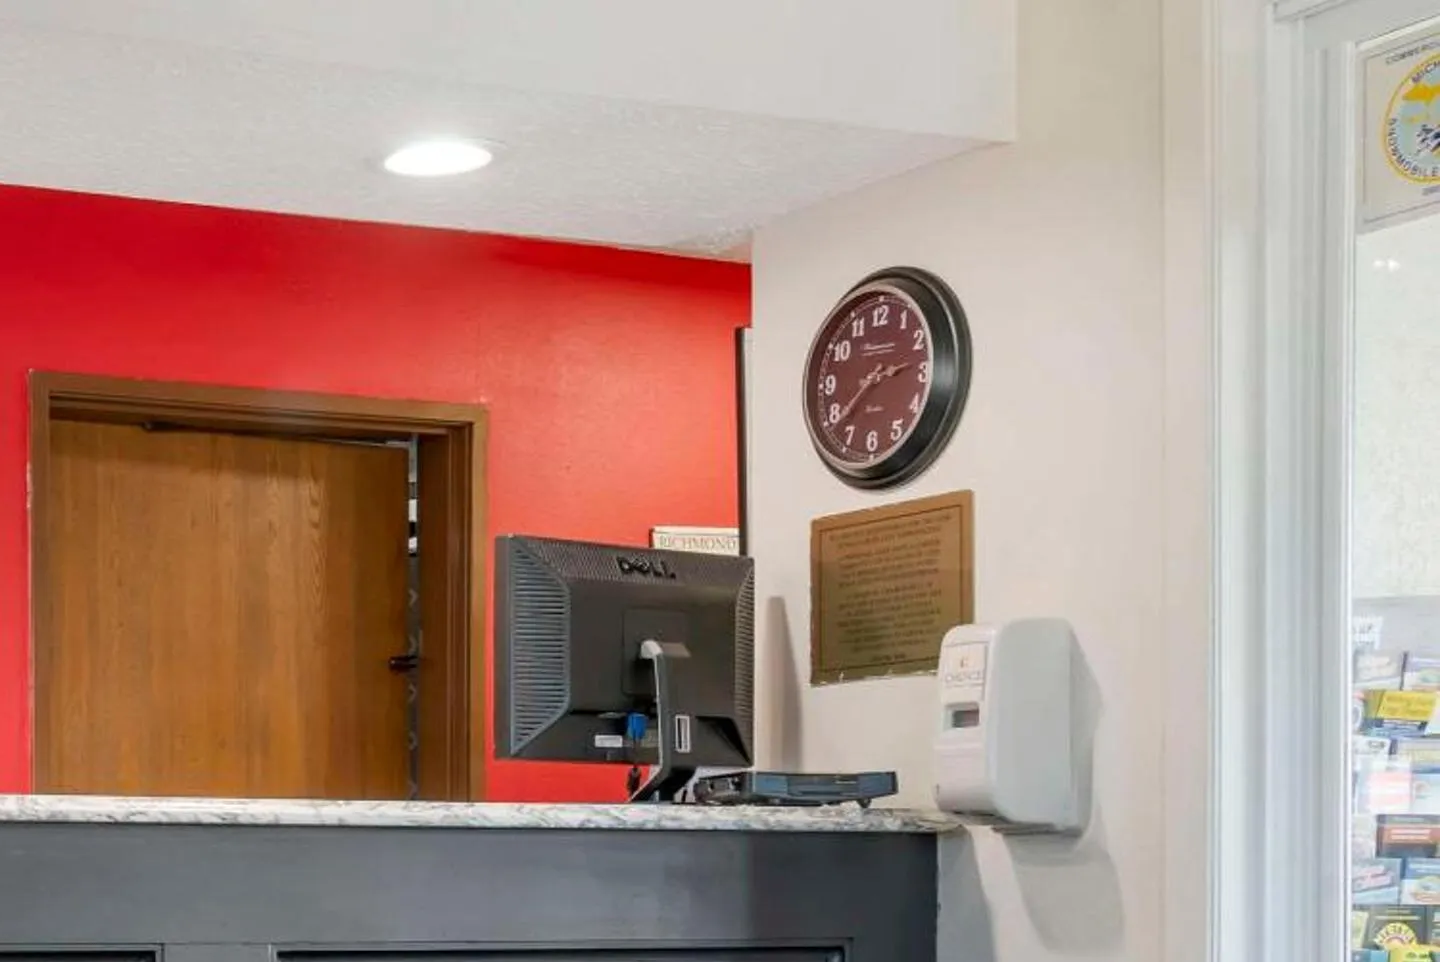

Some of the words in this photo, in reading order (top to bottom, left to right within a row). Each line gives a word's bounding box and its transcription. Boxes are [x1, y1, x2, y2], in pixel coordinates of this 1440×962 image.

[872, 305, 889, 327] 12
[900, 310, 908, 330] 1
[852, 317, 865, 338] 11
[913, 330, 924, 350] 2
[833, 340, 851, 362] 10
[918, 362, 928, 383] 3
[825, 375, 836, 395] 9
[829, 403, 840, 423] 8
[909, 393, 920, 414] 4
[845, 426, 856, 446] 7
[890, 418, 904, 441] 5
[866, 431, 878, 452] 6
[617, 555, 676, 579] DELL
